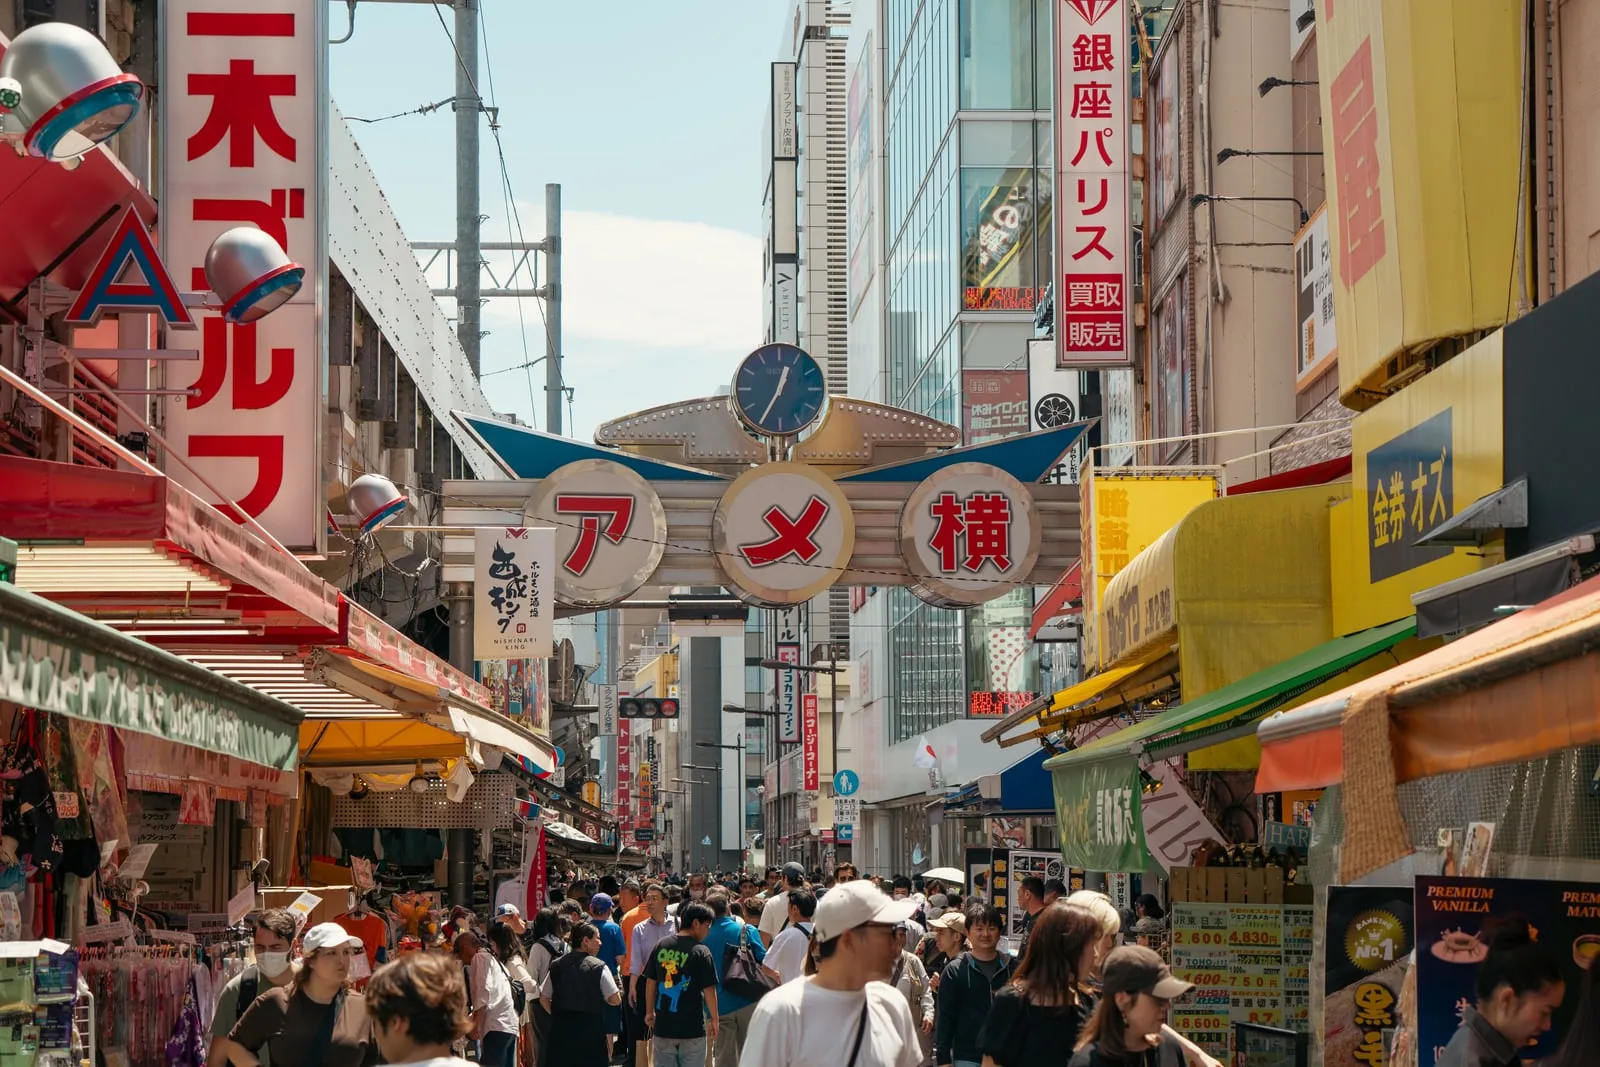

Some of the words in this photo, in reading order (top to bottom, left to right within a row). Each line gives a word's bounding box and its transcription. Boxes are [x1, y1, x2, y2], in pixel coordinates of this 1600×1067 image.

[1070, 33, 1115, 262] 銀座パリス
[1068, 280, 1121, 309] 買取
[1068, 321, 1122, 348] 販売
[1372, 445, 1448, 549] 金券オズ
[554, 491, 1013, 576] アメ横
[493, 637, 538, 645] NISHINARI
[805, 698, 818, 787] 銀座コージーコーナー
[1426, 885, 1495, 899] PREMIUM
[1431, 900, 1491, 913] VANILLA
[1355, 916, 1393, 931] RANKING
